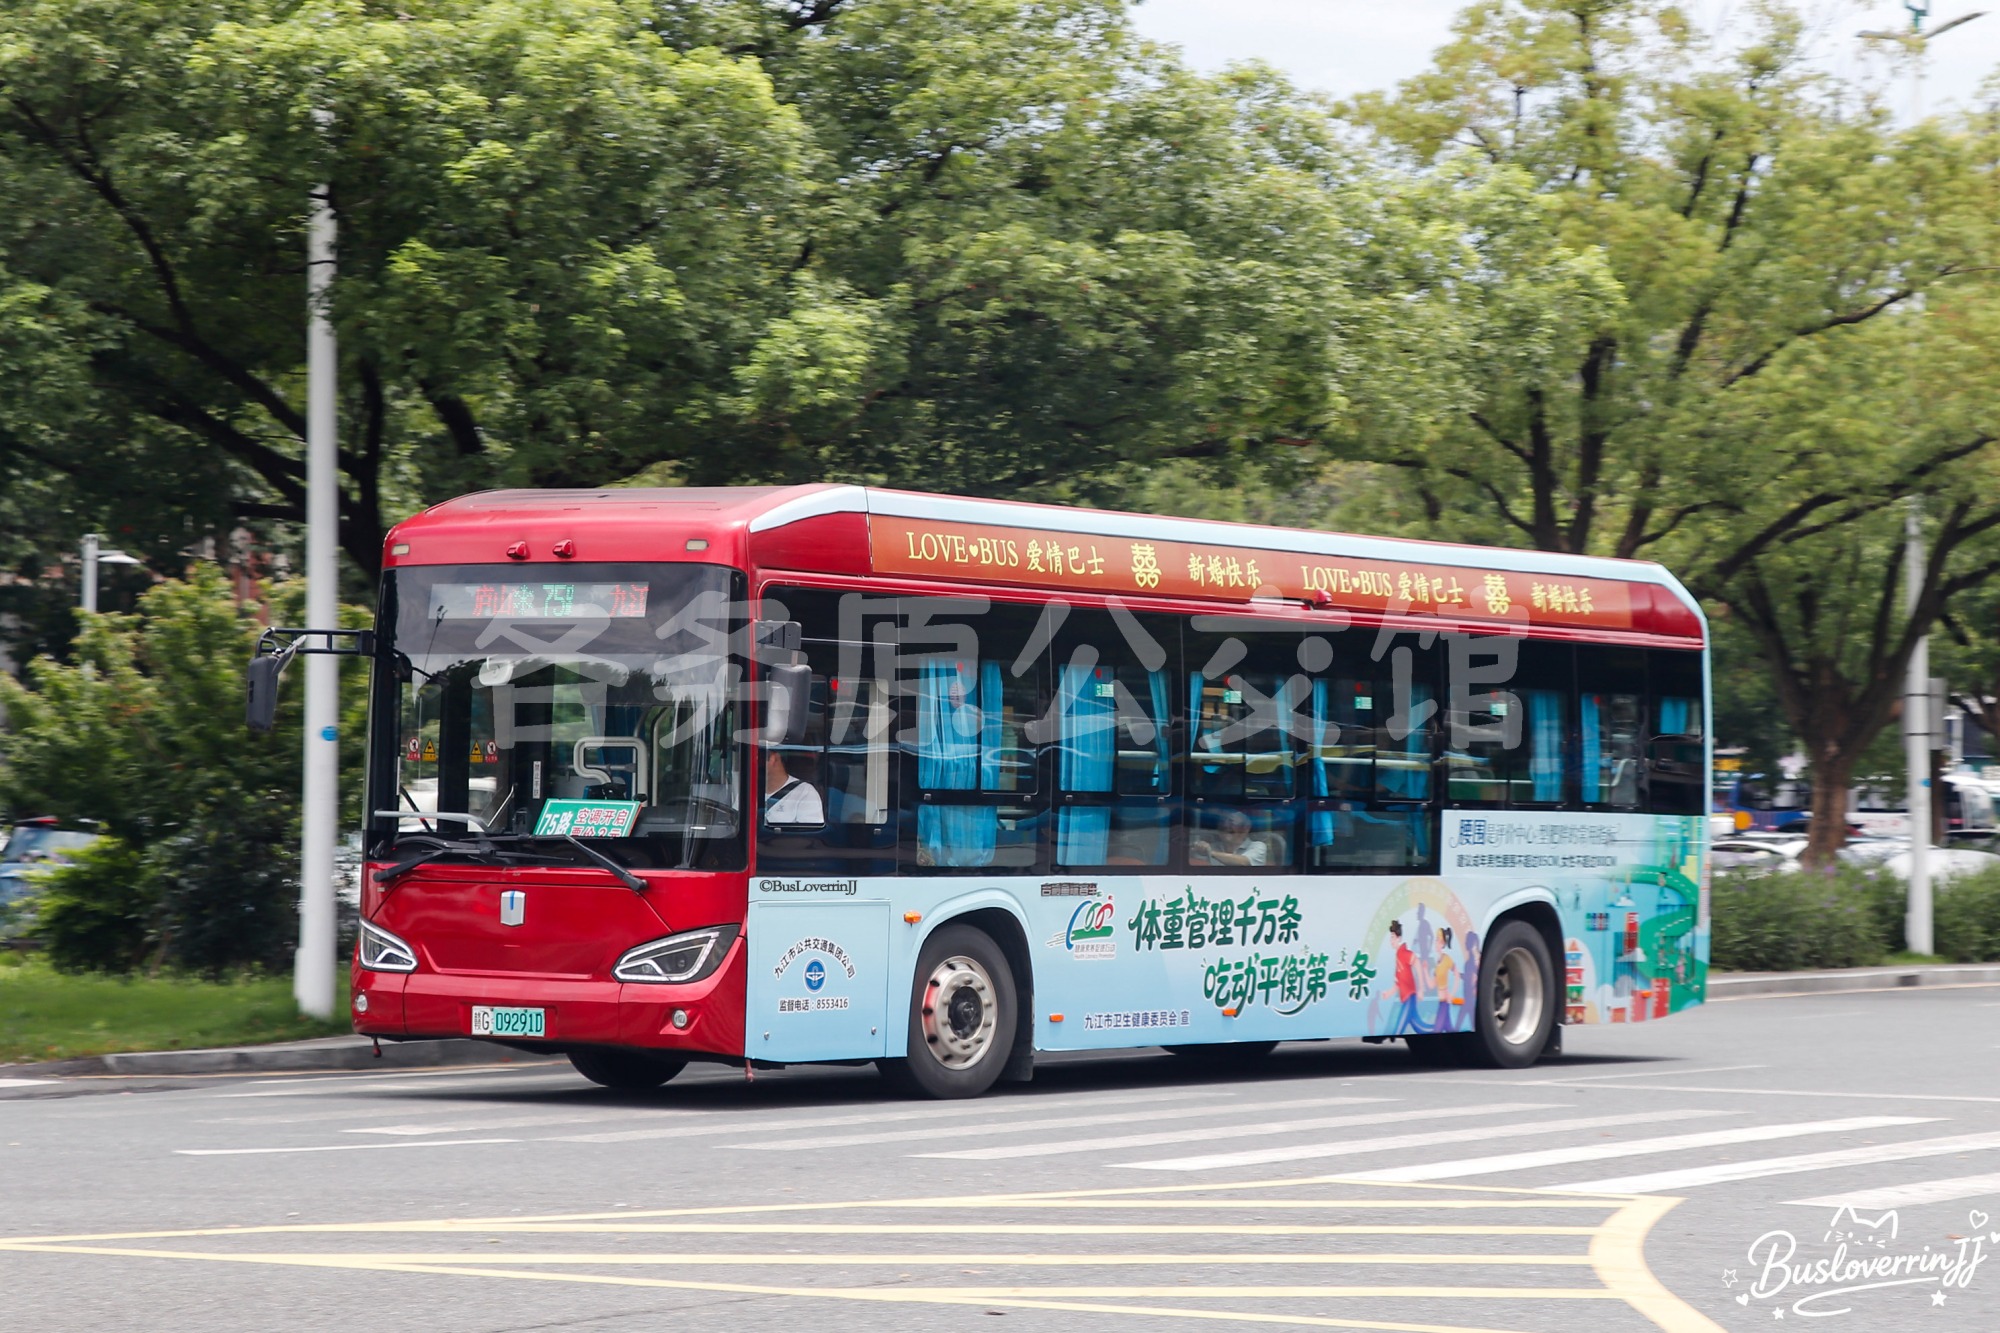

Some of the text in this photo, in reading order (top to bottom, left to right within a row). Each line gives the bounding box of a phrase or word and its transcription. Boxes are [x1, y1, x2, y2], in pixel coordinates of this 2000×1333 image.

[1025, 539, 1105, 576] 爱情巴士
[1187, 552, 1263, 590] 新婚快乐
[608, 584, 650, 617] 九江
[1397, 571, 1464, 605] 爱情巴士
[1530, 582, 1595, 616] 新婚快乐
[540, 812, 574, 836] 75路
[574, 808, 629, 827] 空调开启
[1128, 893, 1302, 952] 体重管理千万条
[774, 938, 856, 979] 九江市公共交通集团公司
[1204, 950, 1377, 1016] 吃动平衡第一条
[1084, 1010, 1190, 1029] 九江市卫生健康委员会 宣
